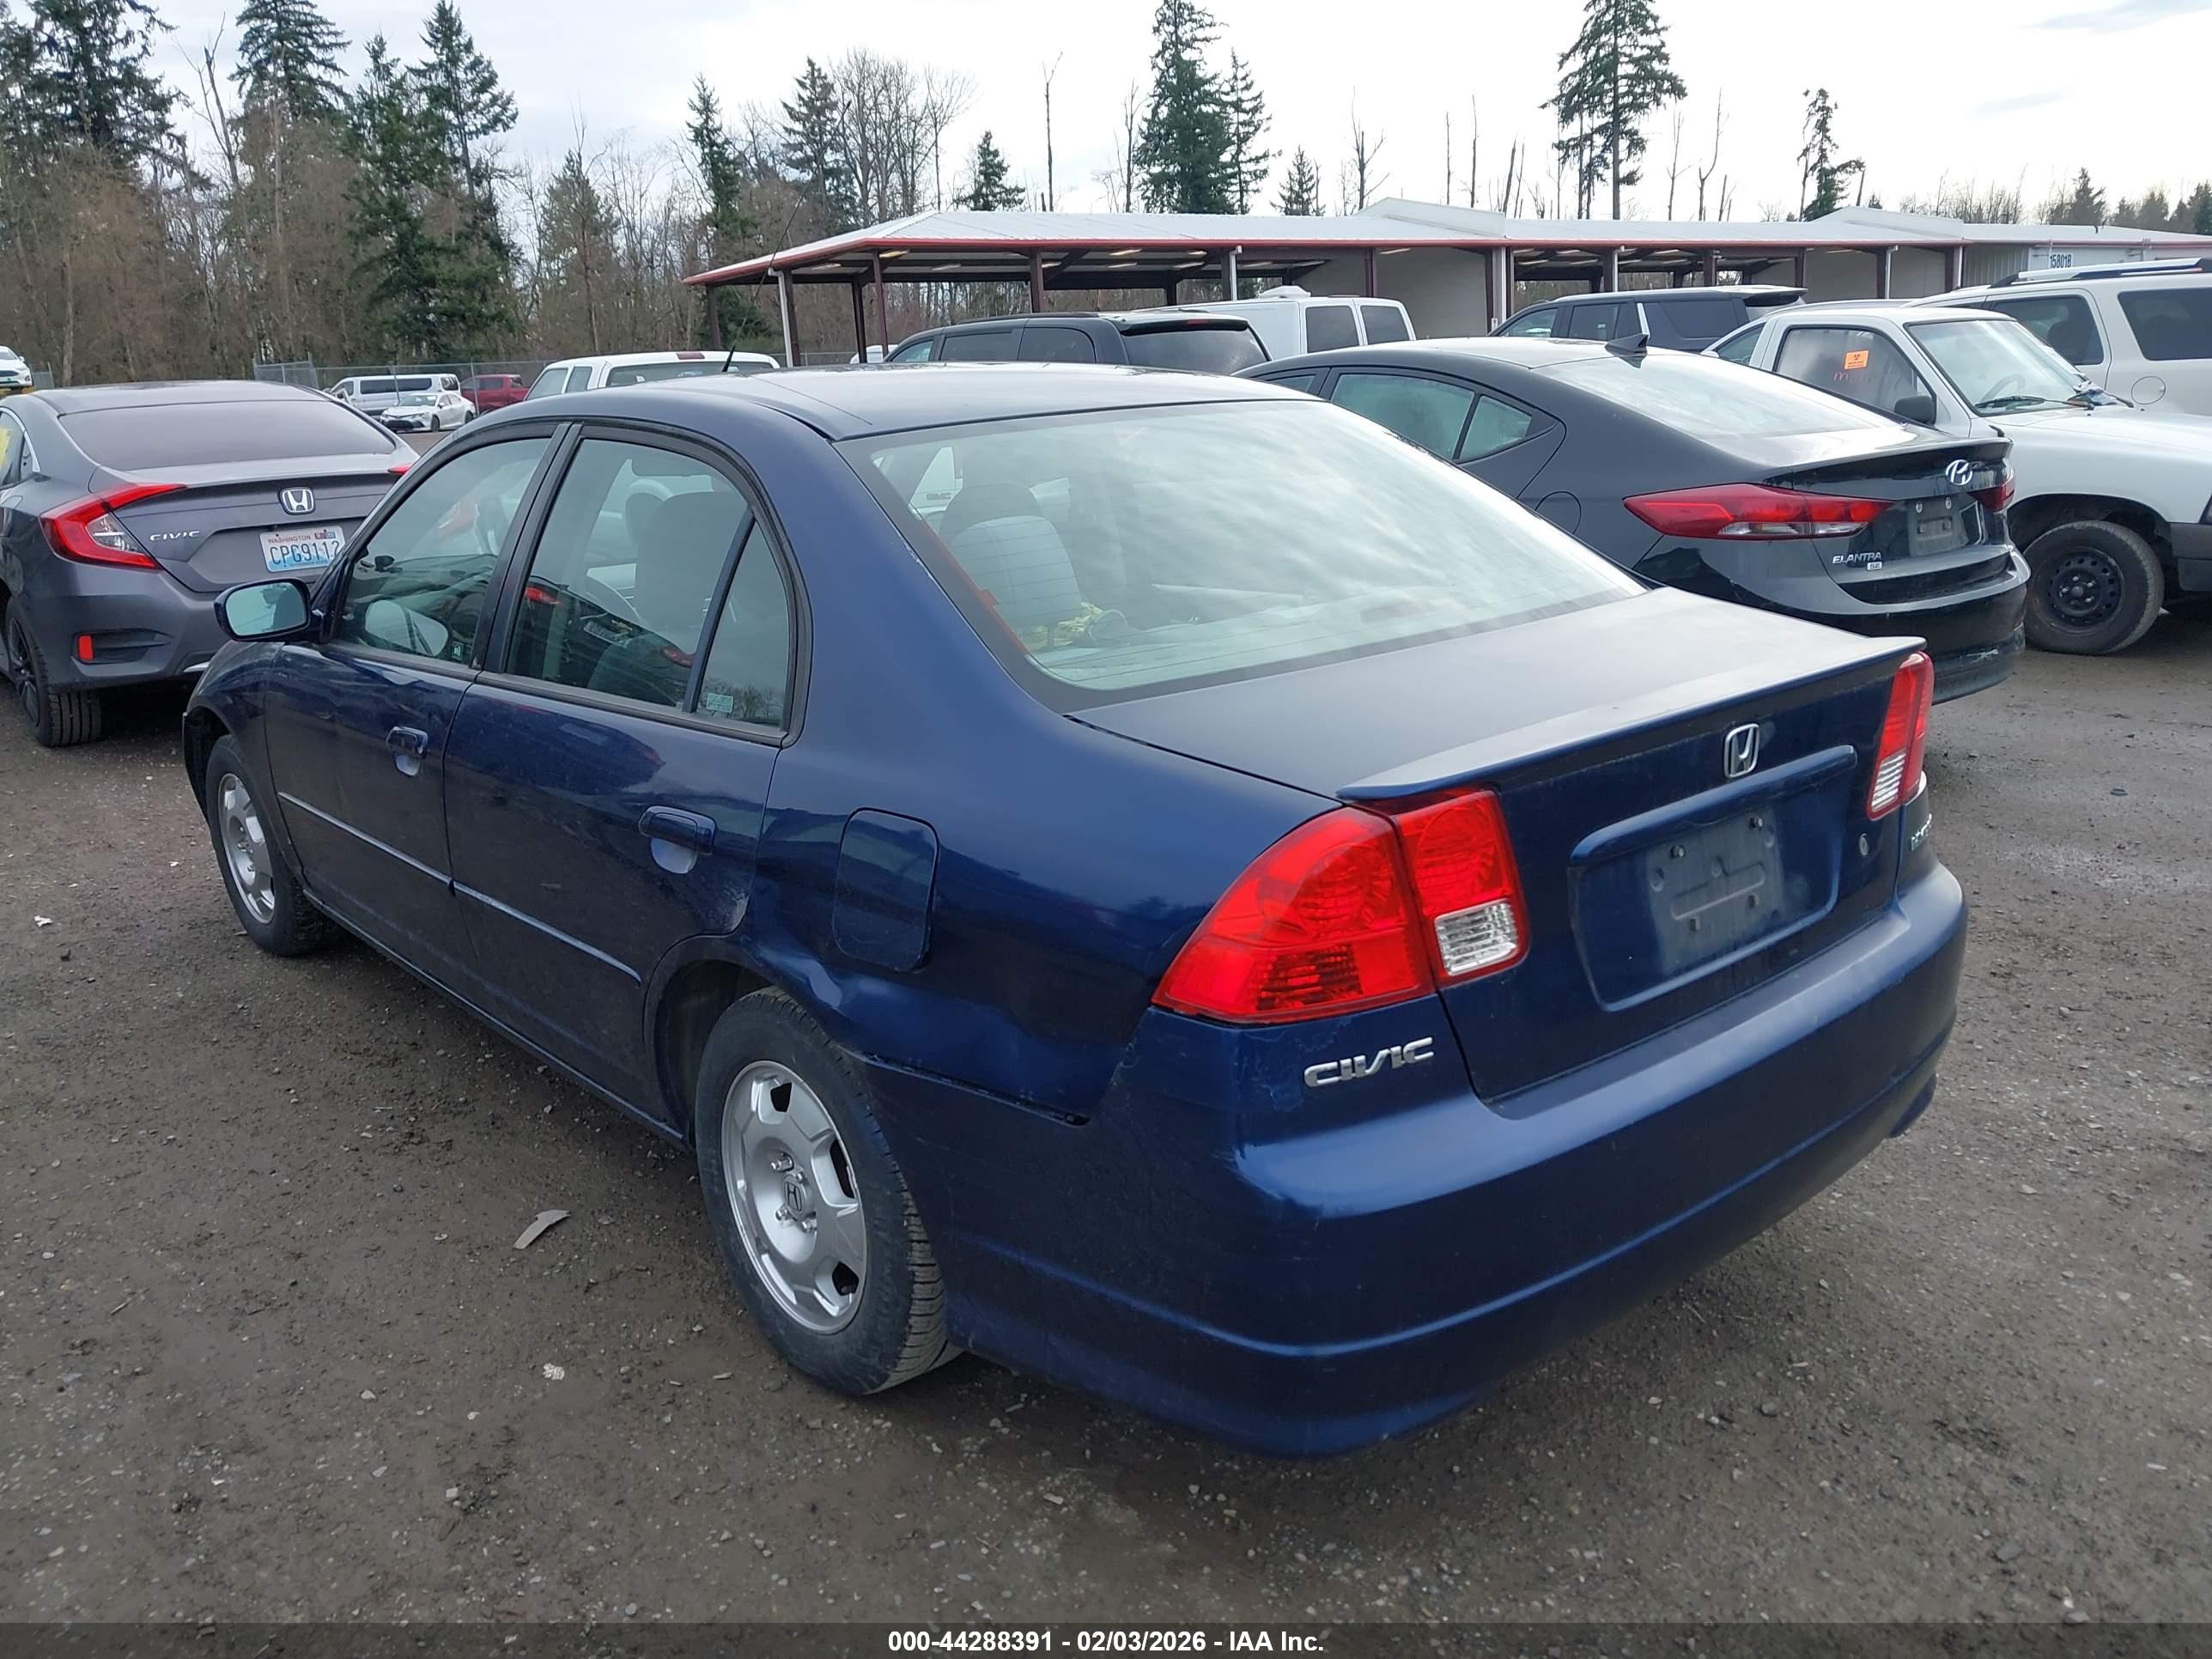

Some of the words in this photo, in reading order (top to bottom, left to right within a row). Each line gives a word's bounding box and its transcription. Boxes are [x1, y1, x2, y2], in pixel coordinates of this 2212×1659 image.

[149, 531, 200, 541] CIVIC
[268, 535, 311, 544] WASHINGTON
[1832, 552, 1882, 564] ELANTRA
[1304, 1036, 1434, 1087] CIVIC
